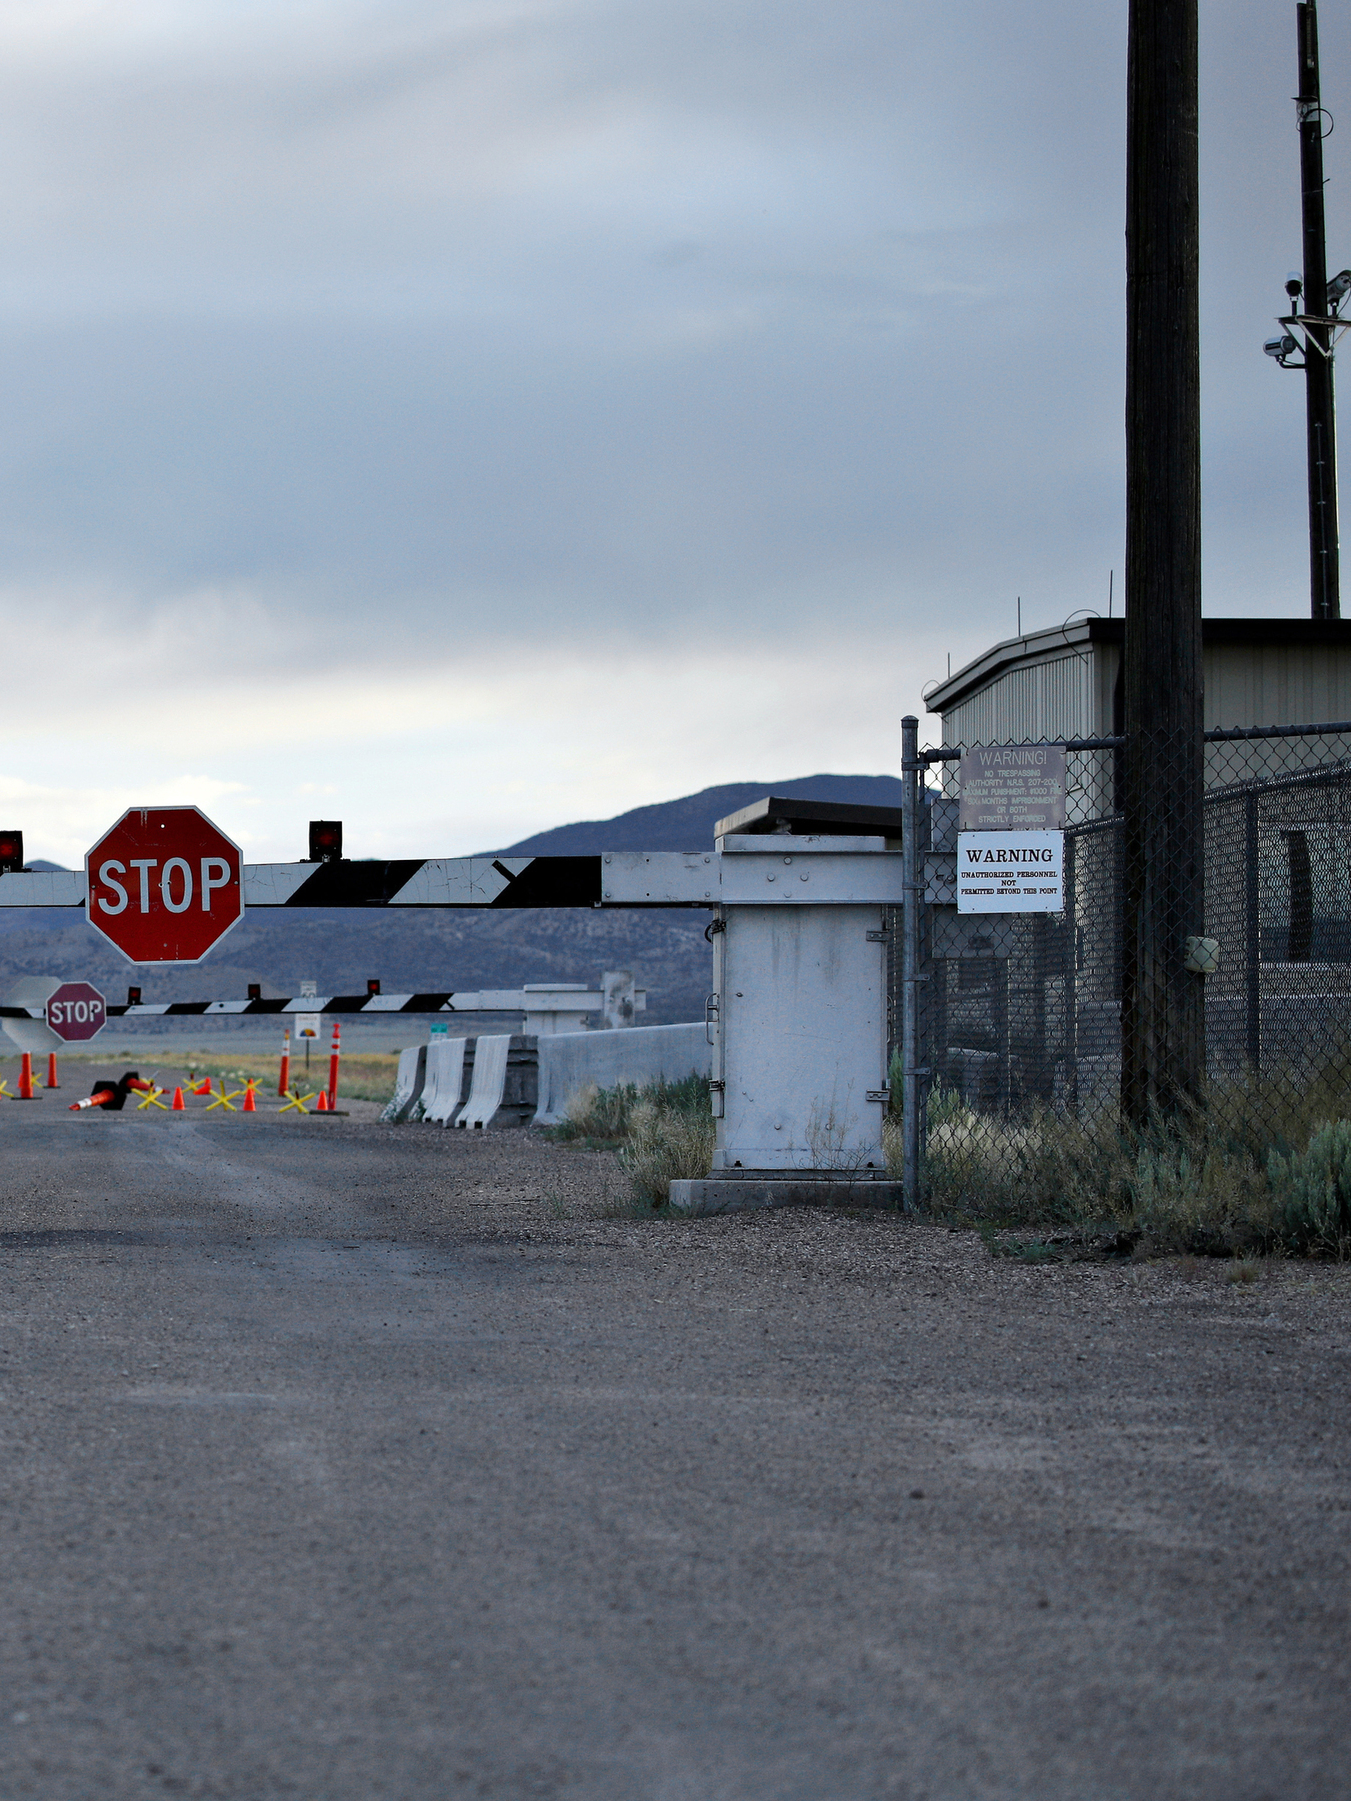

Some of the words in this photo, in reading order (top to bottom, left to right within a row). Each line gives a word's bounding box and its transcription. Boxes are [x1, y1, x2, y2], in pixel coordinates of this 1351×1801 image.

[980, 751, 1047, 766] WARNING!
[966, 849, 1053, 862] WARNING
[98, 857, 231, 915] STOP
[51, 1000, 102, 1024] STOP
